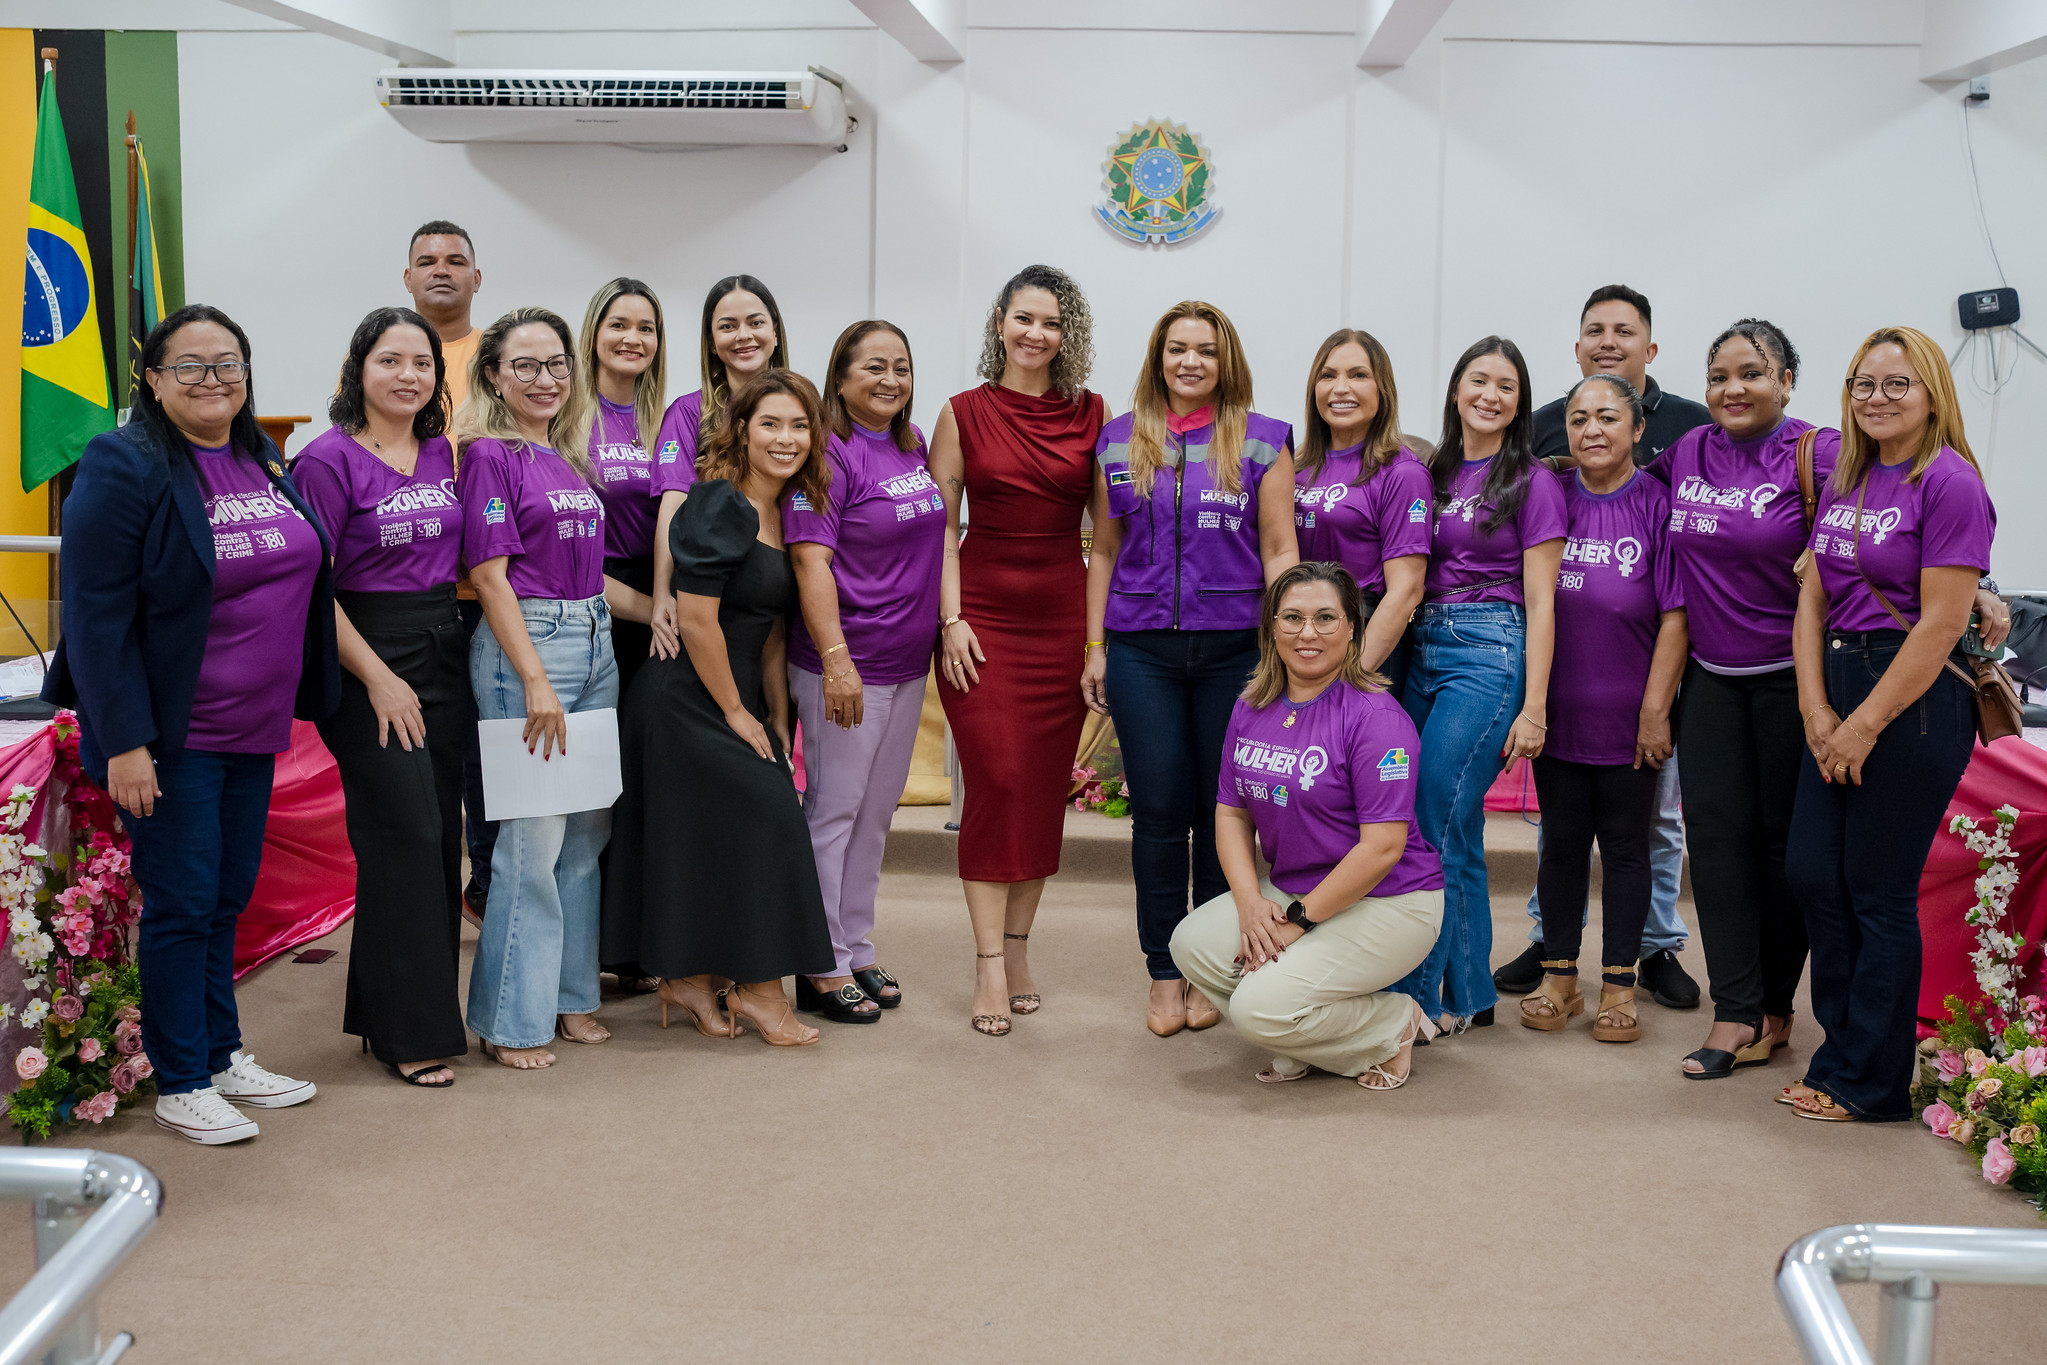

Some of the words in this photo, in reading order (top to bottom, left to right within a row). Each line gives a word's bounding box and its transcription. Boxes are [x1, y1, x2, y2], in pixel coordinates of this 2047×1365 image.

[41, 274, 61, 335] PROGRESSO
[1200, 491, 1239, 506] MULHER
[1676, 480, 1746, 508] MULHER
[376, 488, 453, 515] MULHER
[208, 497, 287, 527] MULHER
[1692, 511, 1719, 520] Denuncie
[380, 520, 413, 531] Violência
[415, 516, 441, 525] Denuncie
[1696, 518, 1718, 534] 180
[251, 527, 280, 536] Denuncie
[380, 526, 408, 535] contra
[424, 522, 442, 538] 180
[213, 531, 249, 541] Violência
[214, 537, 245, 546] contra
[262, 532, 287, 550] 180
[381, 531, 413, 542] MULHER
[389, 537, 413, 546] CRIME
[1579, 537, 1603, 545] ESPECIAL
[215, 543, 253, 553] MULHER
[225, 548, 255, 559] CRIME
[1561, 541, 1611, 565] LHER
[1561, 574, 1584, 590] 180
[1271, 744, 1293, 754] ESPECIAL
[1233, 742, 1297, 775] MULHER
[1382, 769, 1408, 778] Legislativa
[1245, 778, 1268, 788] Denuncie
[1251, 785, 1269, 800] 180
